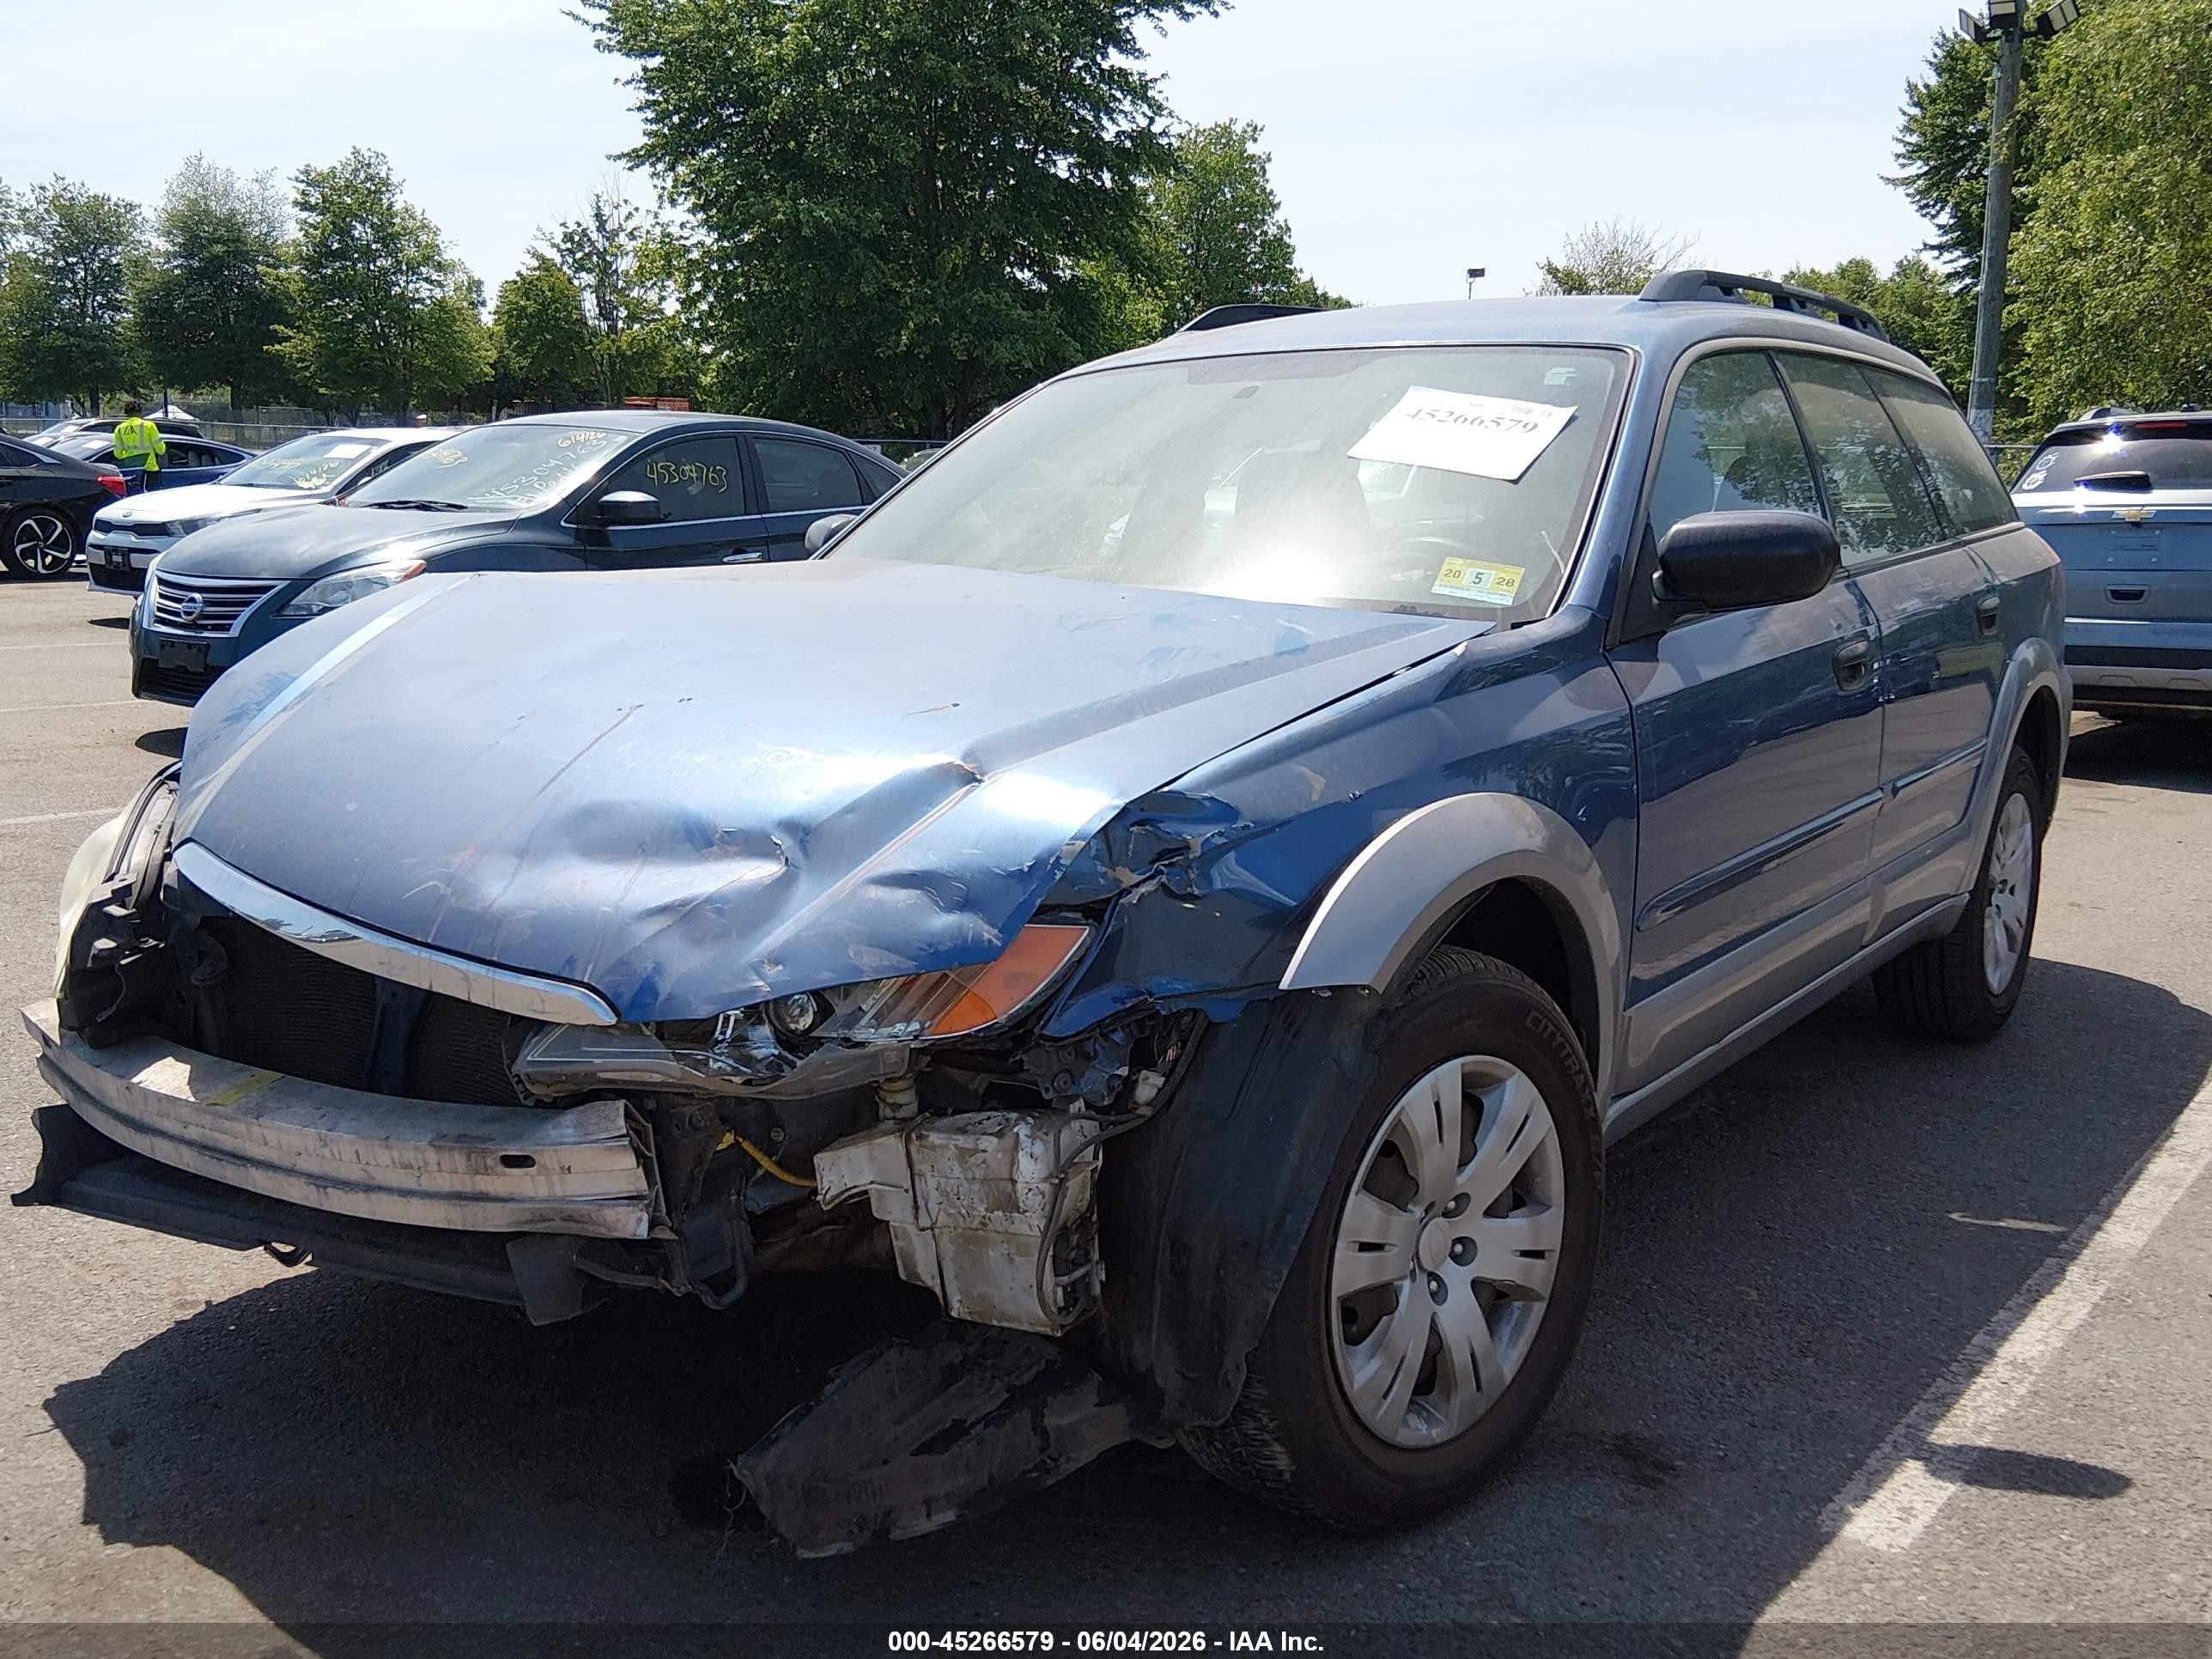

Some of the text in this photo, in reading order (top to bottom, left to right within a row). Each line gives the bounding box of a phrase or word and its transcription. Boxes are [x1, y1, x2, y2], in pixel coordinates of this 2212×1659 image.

[1405, 407, 1539, 434] 45266579
[647, 462, 727, 494] 45304763
[1443, 568, 1516, 587] 20 5 28
